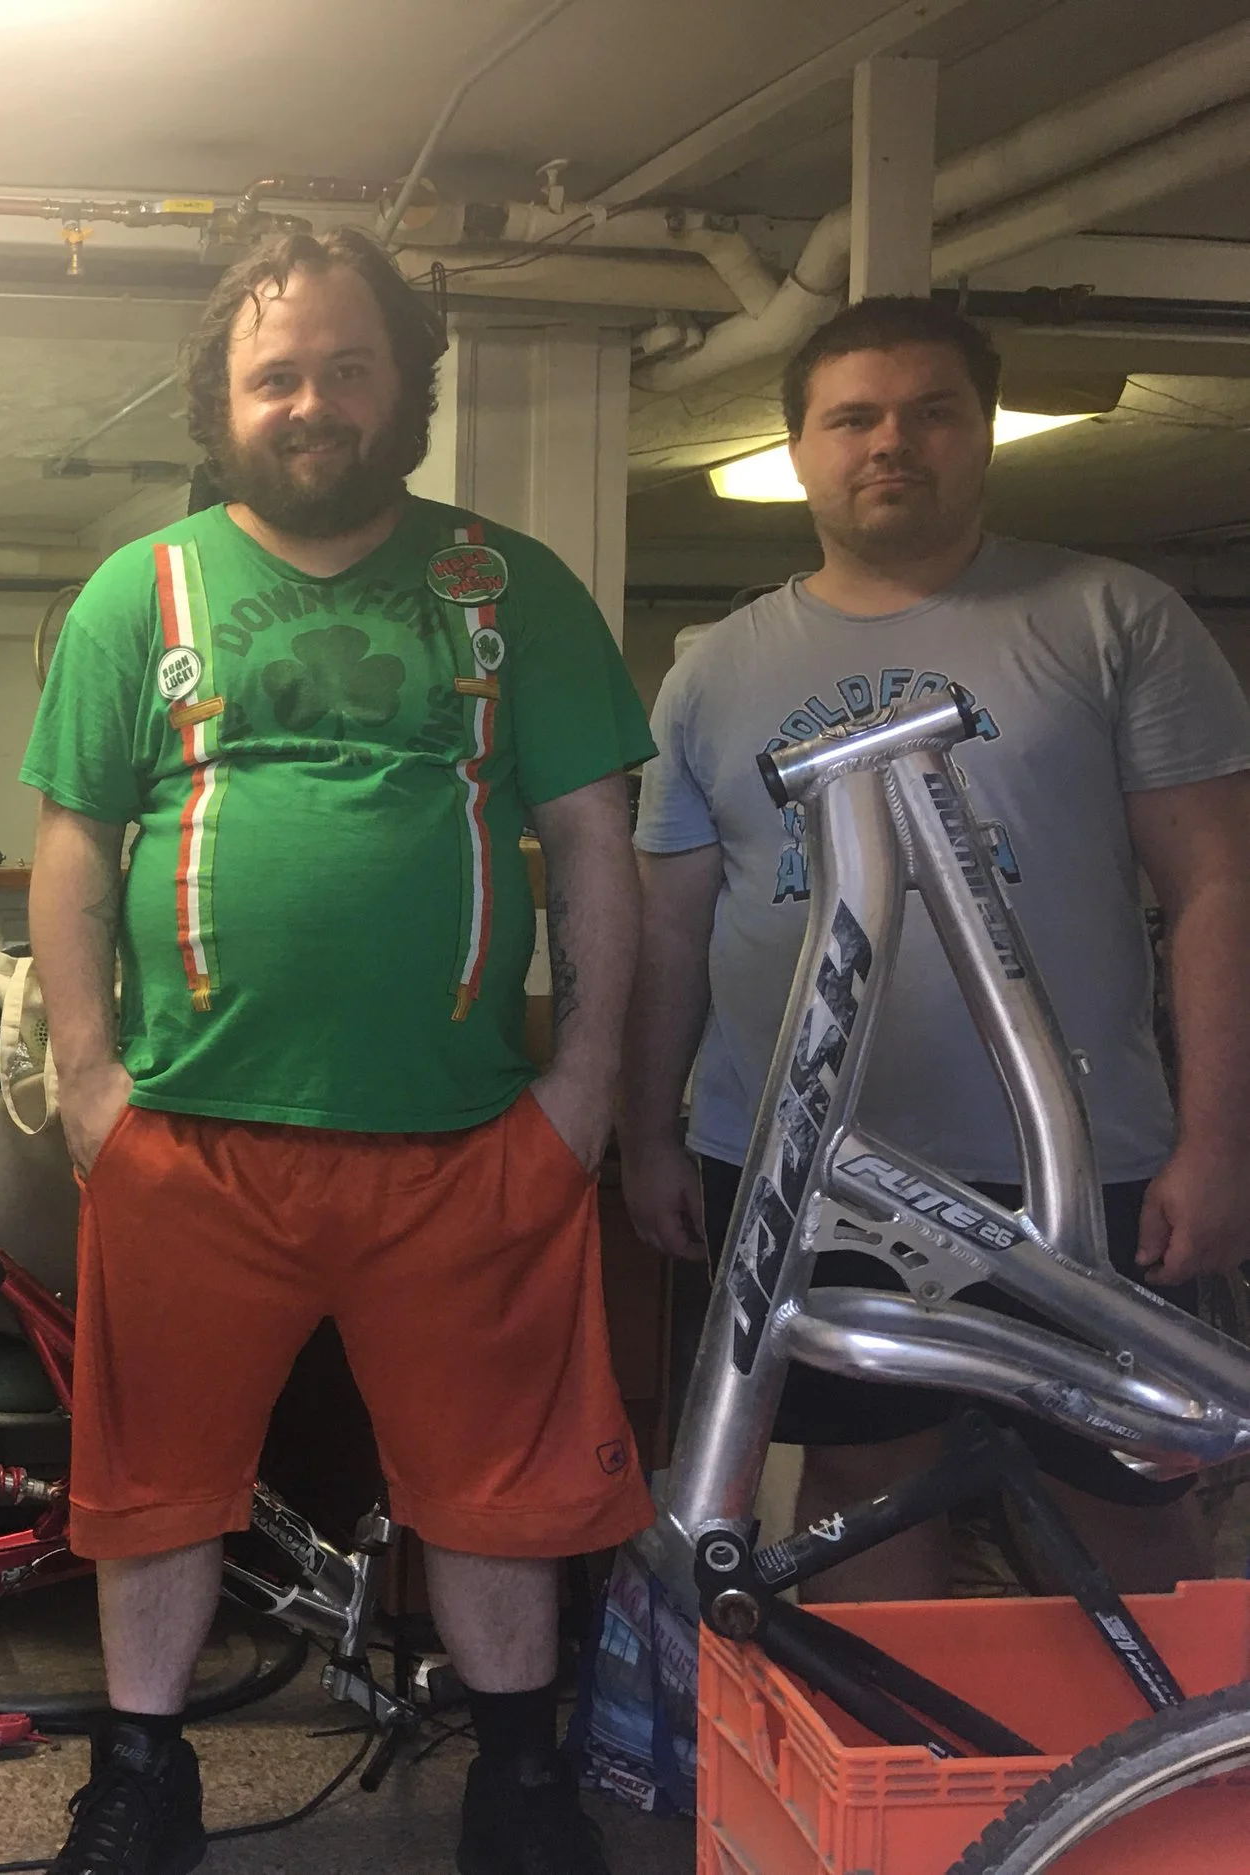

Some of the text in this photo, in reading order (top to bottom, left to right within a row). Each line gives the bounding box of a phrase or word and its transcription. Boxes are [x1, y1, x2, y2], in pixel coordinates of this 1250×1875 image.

[212, 580, 338, 658] DOWN
[162, 655, 190, 680] BORN
[164, 666, 195, 691] LUCKY
